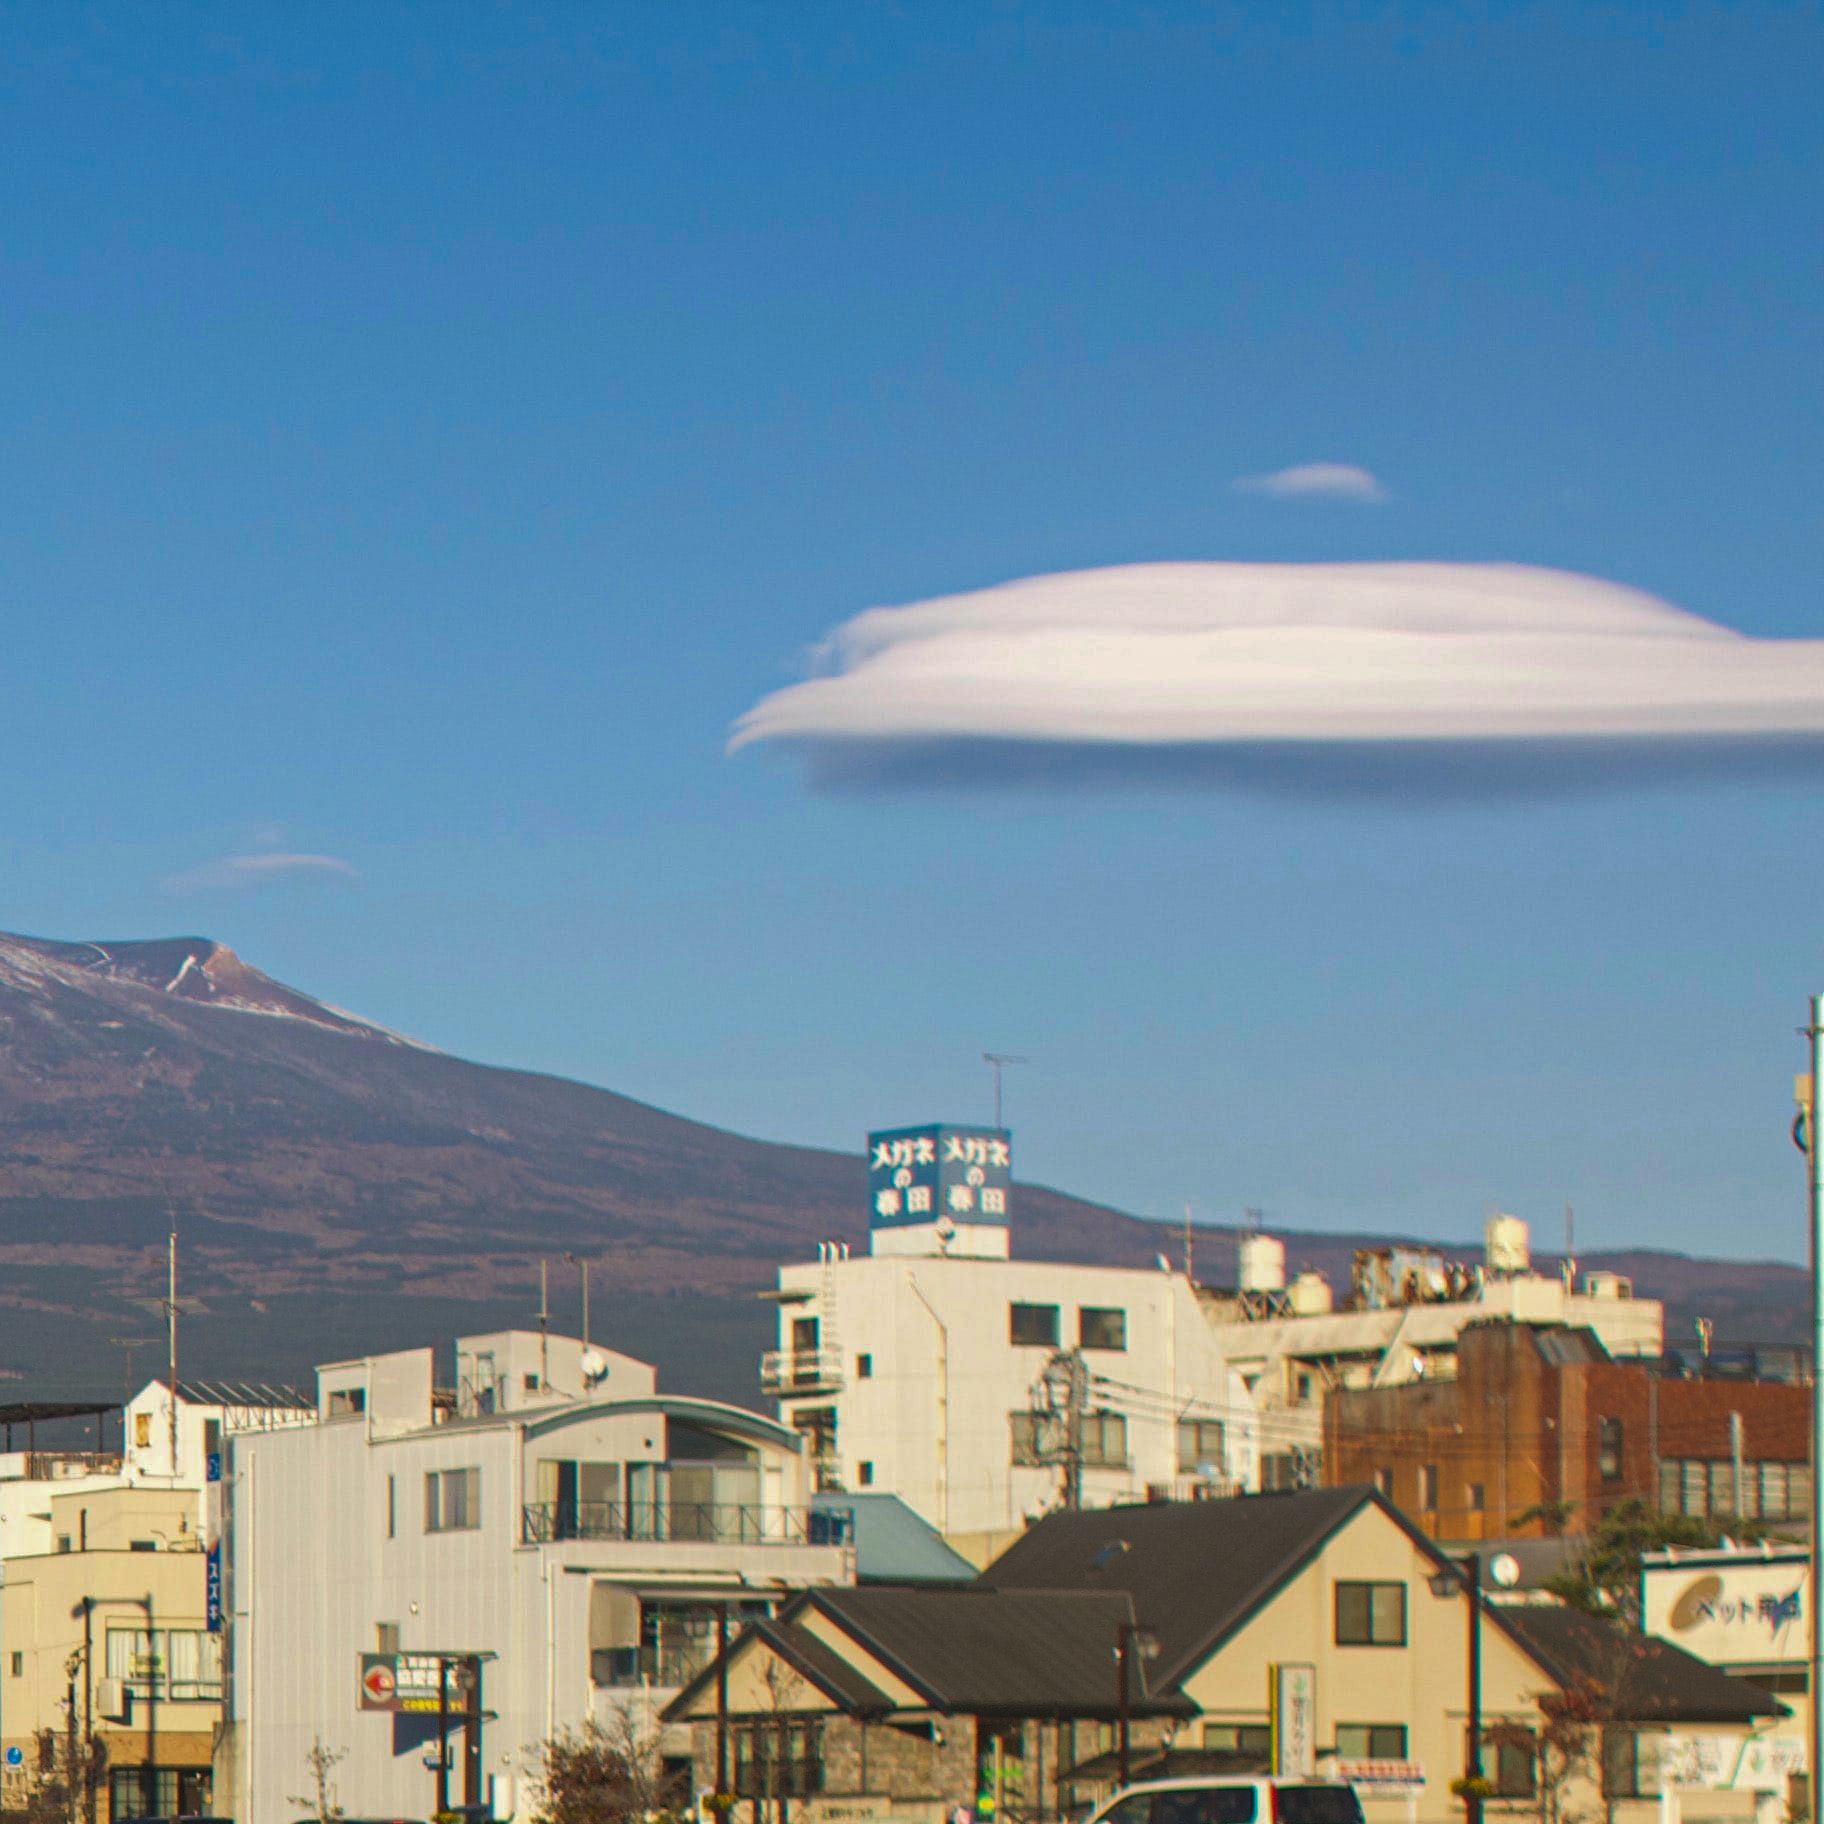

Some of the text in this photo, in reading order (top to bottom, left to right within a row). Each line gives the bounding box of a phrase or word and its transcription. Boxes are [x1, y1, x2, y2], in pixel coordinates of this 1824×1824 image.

[871, 1137, 936, 1170] メガネ
[944, 1136, 1010, 1168] メガネ
[894, 1167, 913, 1189] の
[966, 1166, 986, 1187] の
[876, 1185, 931, 1217] 春田
[949, 1183, 1006, 1214] 春田
[208, 1562, 219, 1622] スズキ
